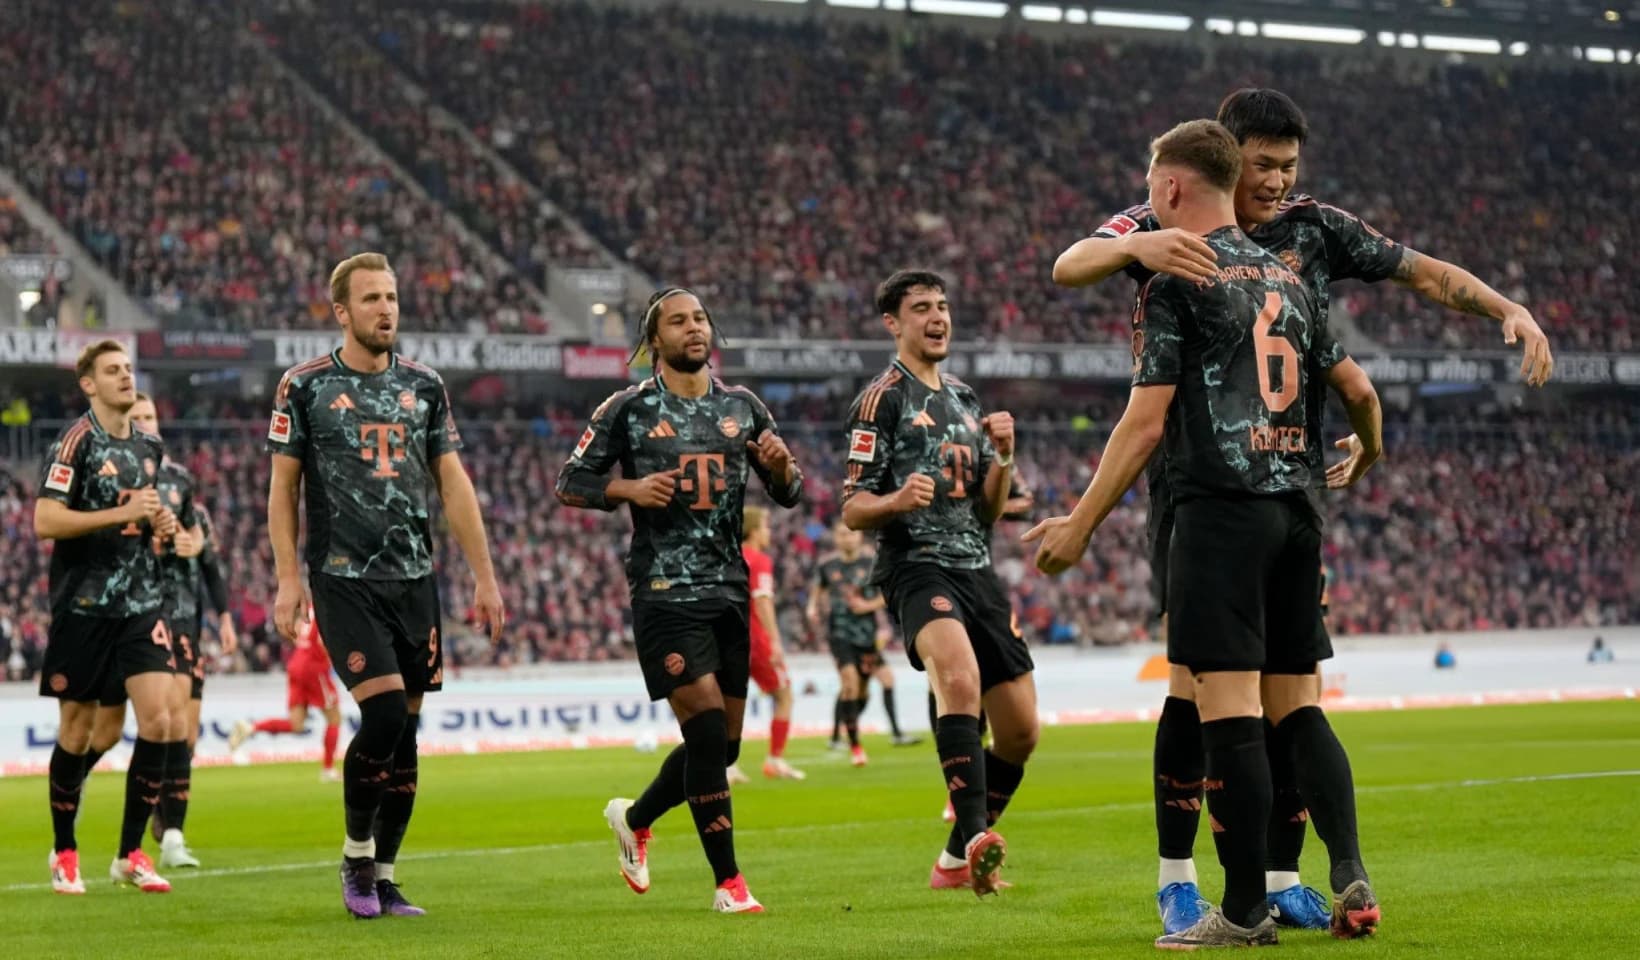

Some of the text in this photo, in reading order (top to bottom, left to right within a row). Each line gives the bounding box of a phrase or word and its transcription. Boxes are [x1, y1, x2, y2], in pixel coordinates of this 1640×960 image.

[1253, 291, 1299, 413] 6
[360, 423, 406, 478] T
[679, 453, 727, 510] T
[427, 626, 438, 667] 9
